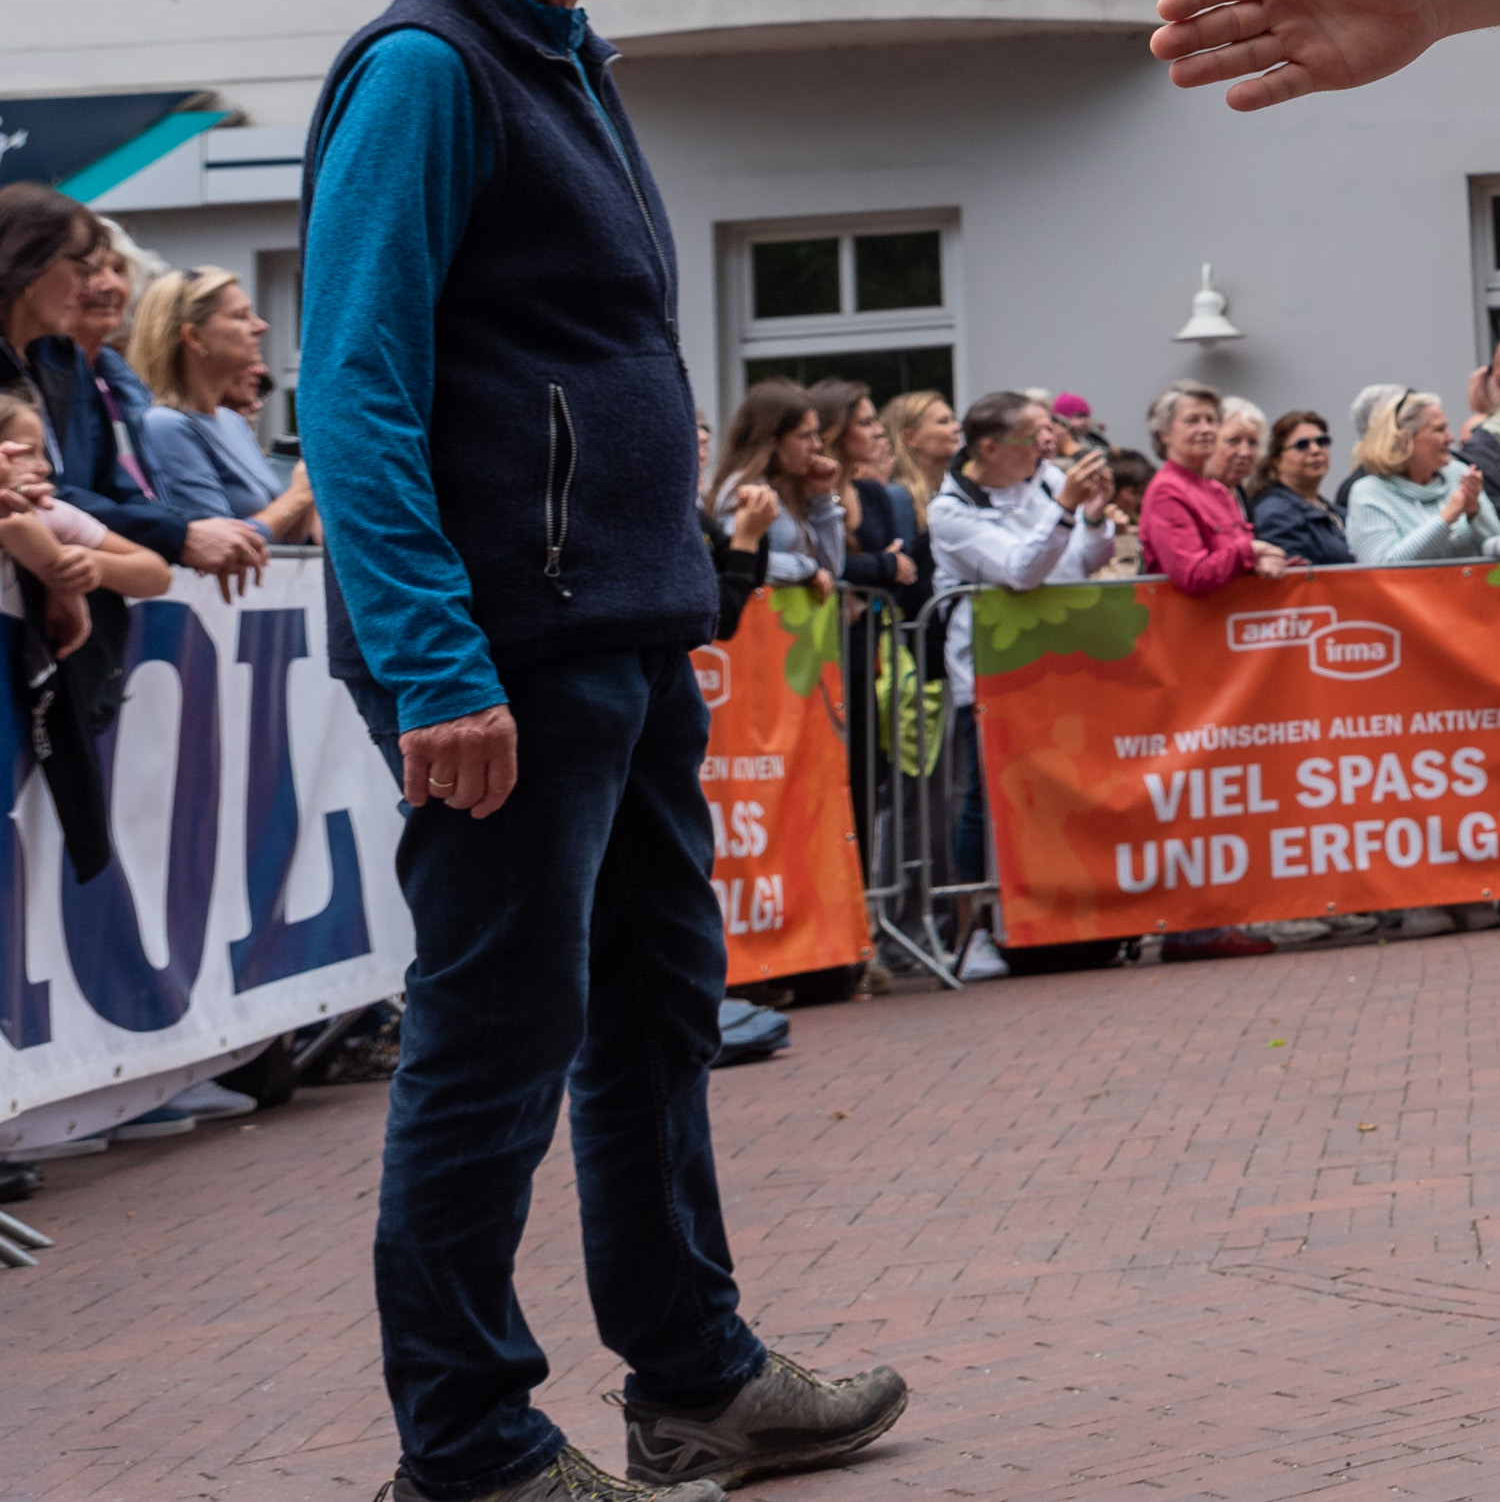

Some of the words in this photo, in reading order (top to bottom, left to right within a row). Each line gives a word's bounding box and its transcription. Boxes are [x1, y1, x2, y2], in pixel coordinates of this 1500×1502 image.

[1242, 614, 1314, 642] aktiv
[1325, 637, 1387, 662] irma
[1114, 735, 1166, 759] WIR
[1174, 719, 1320, 754] WÜNSCHEN
[1329, 714, 1402, 739] ALLEN
[1143, 763, 1279, 822] VIEL
[1296, 746, 1489, 809] SPASS
[1114, 833, 1249, 895] UND
